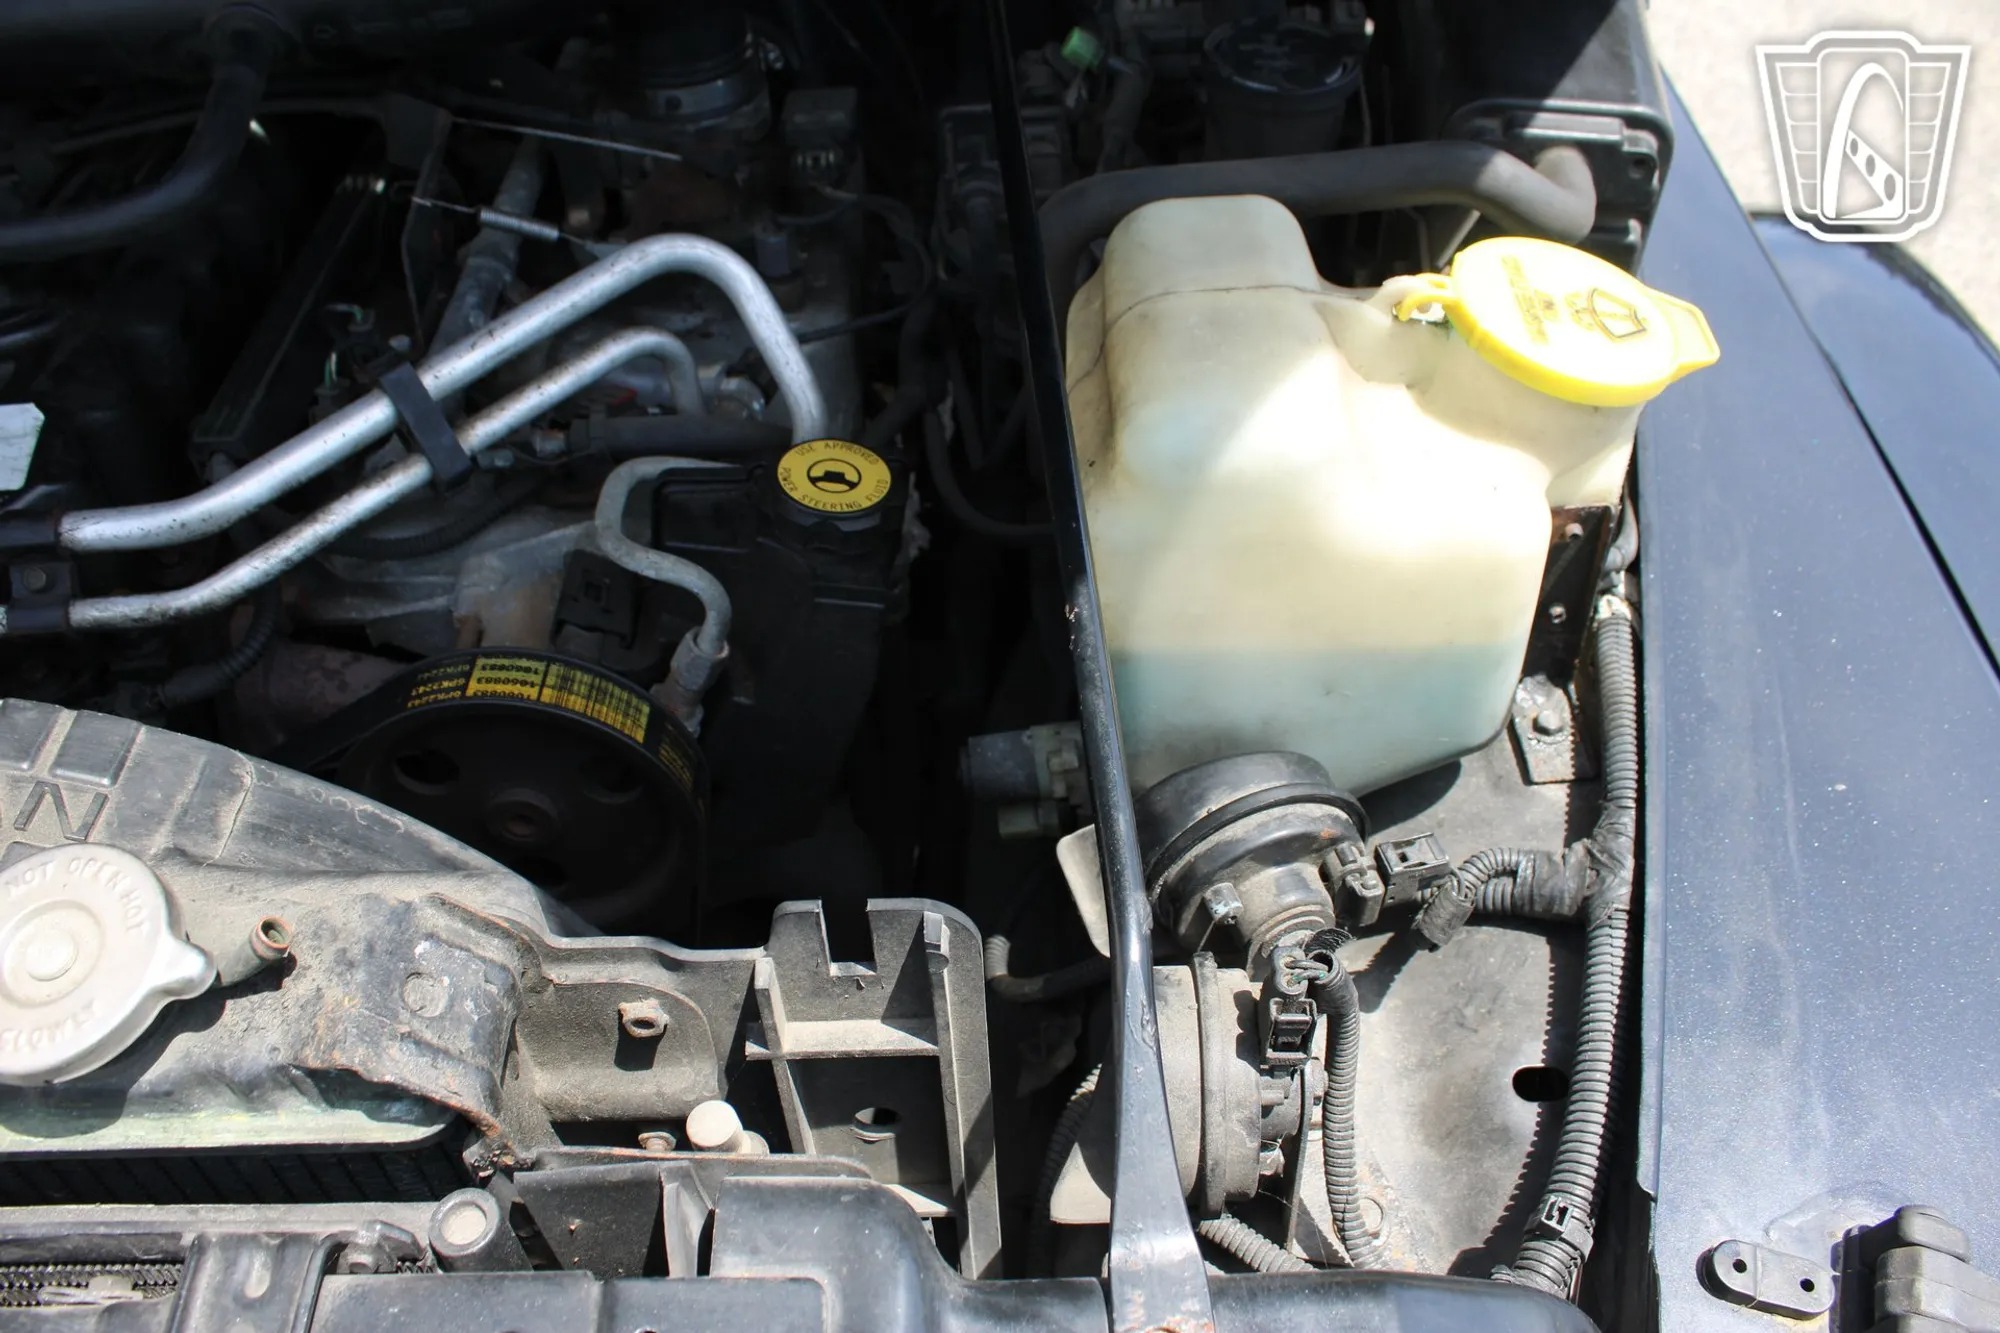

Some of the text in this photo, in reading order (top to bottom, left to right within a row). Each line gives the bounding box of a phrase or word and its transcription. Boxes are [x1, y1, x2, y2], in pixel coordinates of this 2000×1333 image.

[795, 441, 879, 465] USE APPROVED
[779, 467, 889, 511] POWER STEERING FLUID
